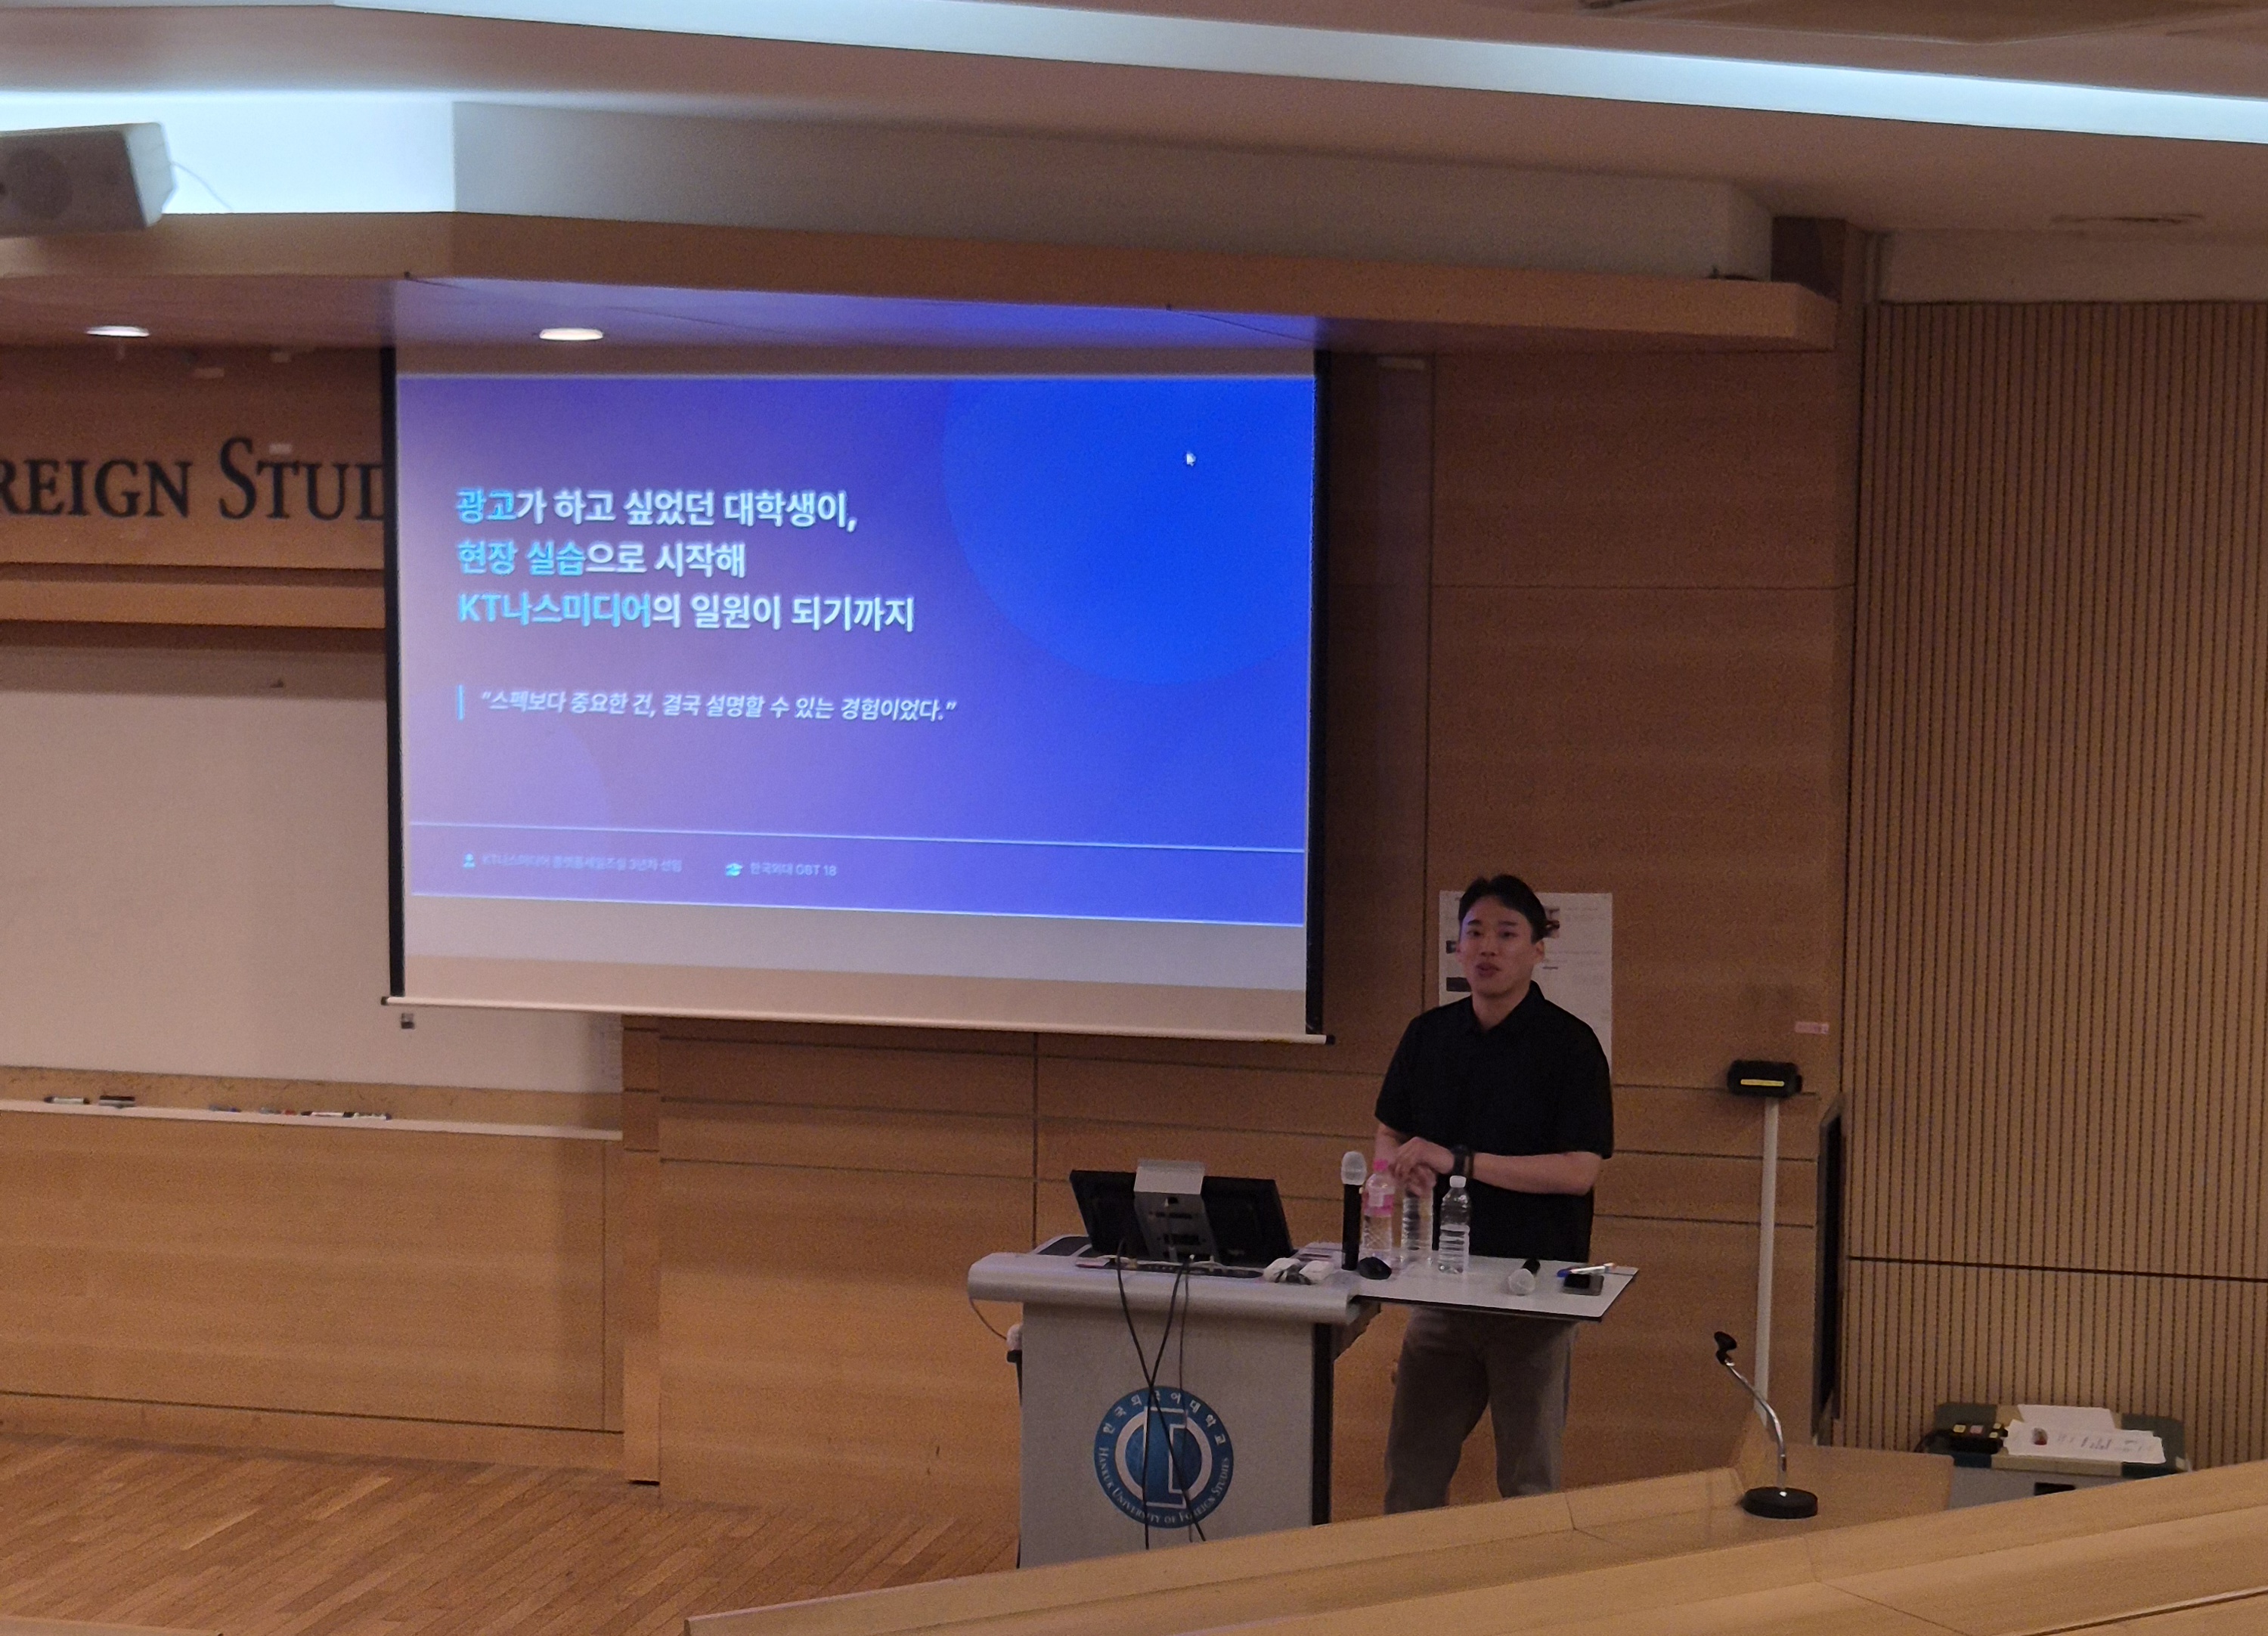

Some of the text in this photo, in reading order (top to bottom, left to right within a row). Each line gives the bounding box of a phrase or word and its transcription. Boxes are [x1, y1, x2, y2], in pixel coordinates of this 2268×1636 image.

[457, 488, 857, 532] 광고가 하고 싶었던 대학생이,
[458, 540, 746, 578] 현장 실습으로 시작해
[458, 592, 914, 632] KT나스미디어의 일원이 되기까지
[572, 692, 629, 714] 중요한
[634, 693, 656, 718] 건,
[663, 694, 702, 716] 결국
[706, 695, 765, 717] 설명할
[770, 697, 789, 719] 수
[795, 697, 834, 719] 있는
